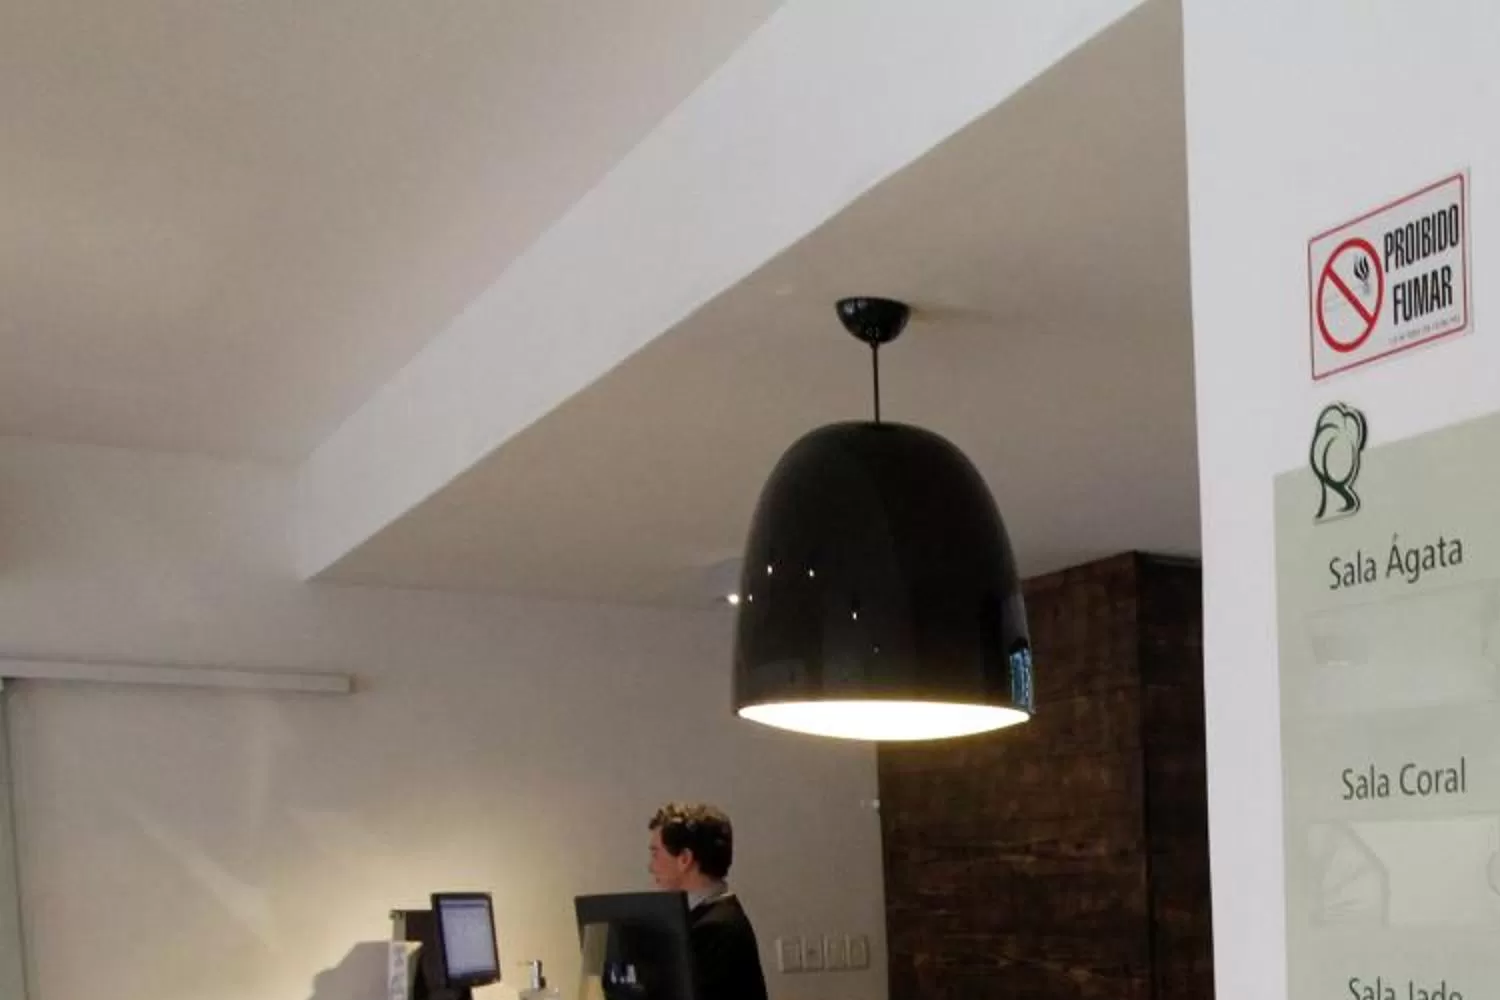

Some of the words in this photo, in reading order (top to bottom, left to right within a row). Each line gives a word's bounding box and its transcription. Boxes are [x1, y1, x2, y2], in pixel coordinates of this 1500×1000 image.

[1383, 204, 1459, 273] PROIBIDO
[1392, 265, 1453, 325] FUMAR
[1329, 550, 1377, 590] Sala
[1385, 532, 1463, 584] Ágata
[1342, 764, 1390, 800] Sala
[1399, 756, 1466, 796] Coral
